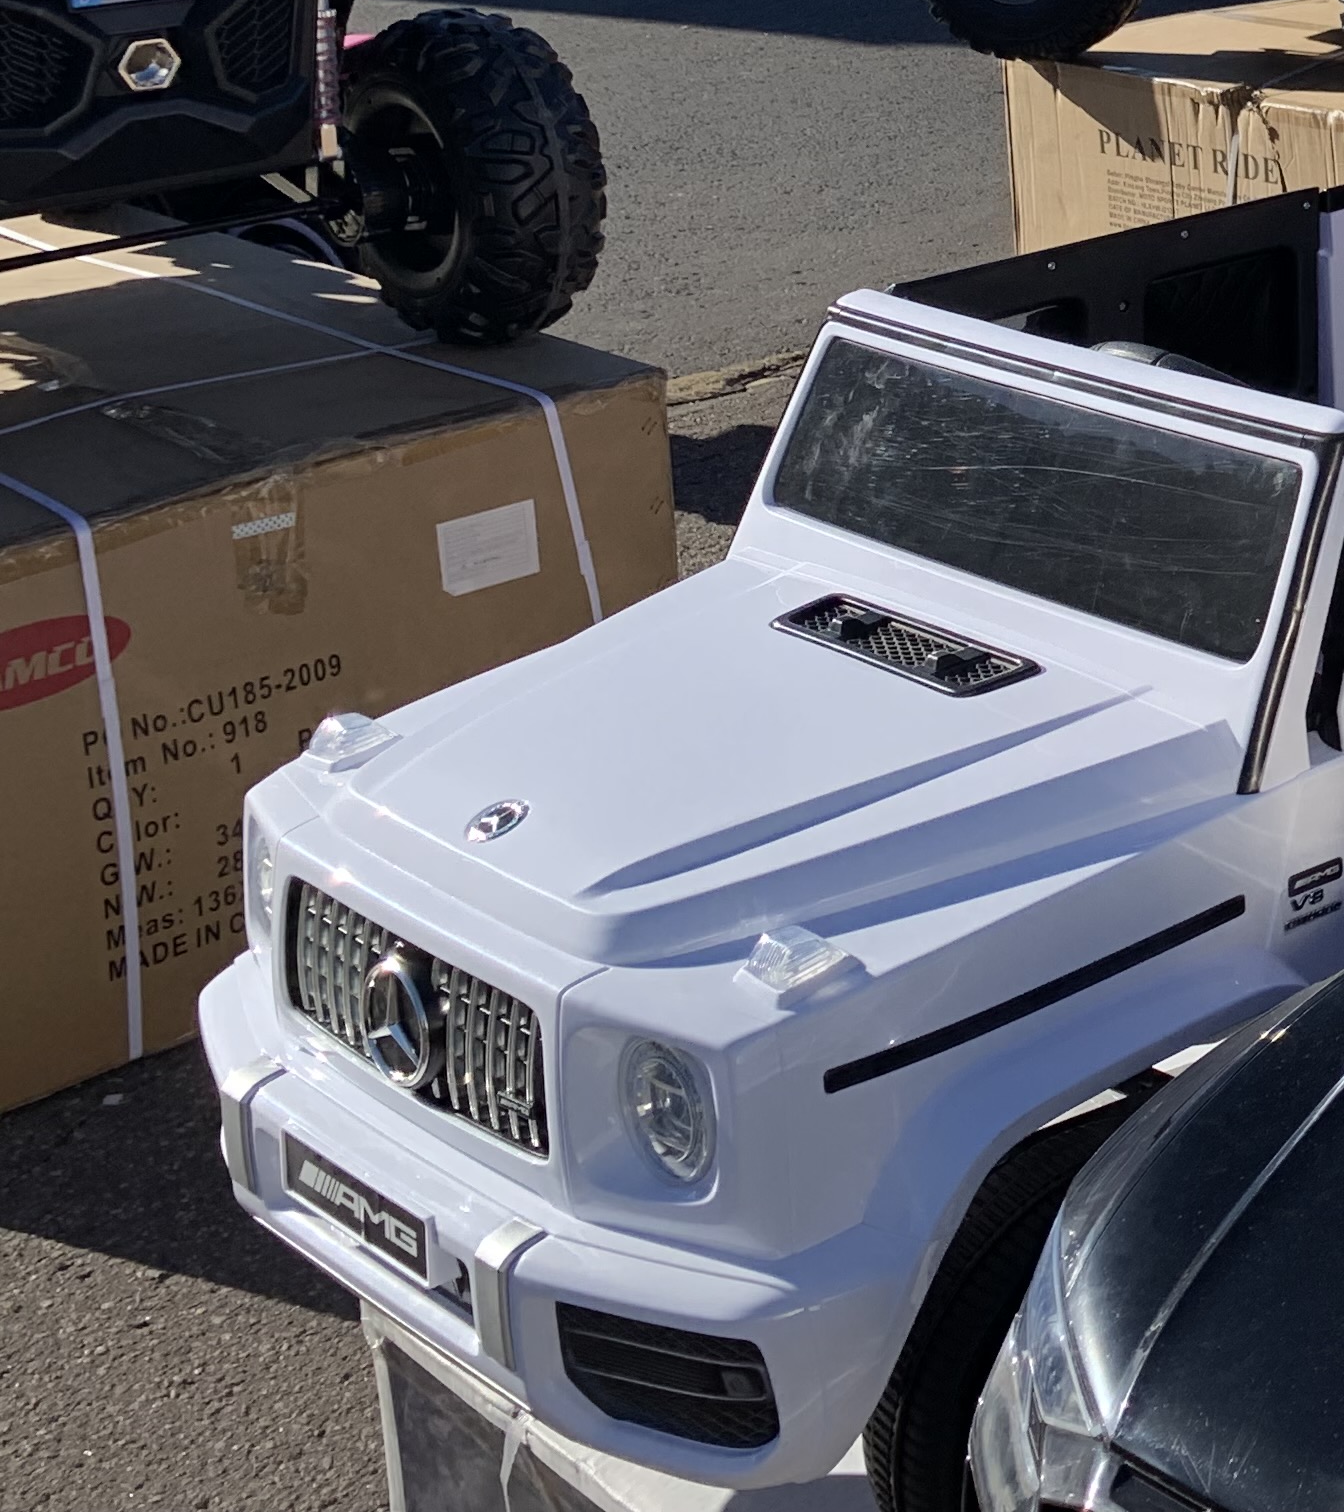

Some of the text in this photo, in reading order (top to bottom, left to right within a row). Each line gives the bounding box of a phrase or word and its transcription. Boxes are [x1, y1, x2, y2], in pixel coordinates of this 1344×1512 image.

[1098, 128, 1203, 171] PLANET
[1212, 148, 1280, 186] RDE
[222, 710, 268, 744] 918
[93, 752, 241, 821] QY: 1
[97, 813, 181, 855] Clor:
[1290, 888, 1324, 912] V8
[107, 908, 184, 951] Mas:
[197, 921, 221, 948] IN
[316, 1170, 418, 1258] AMG
